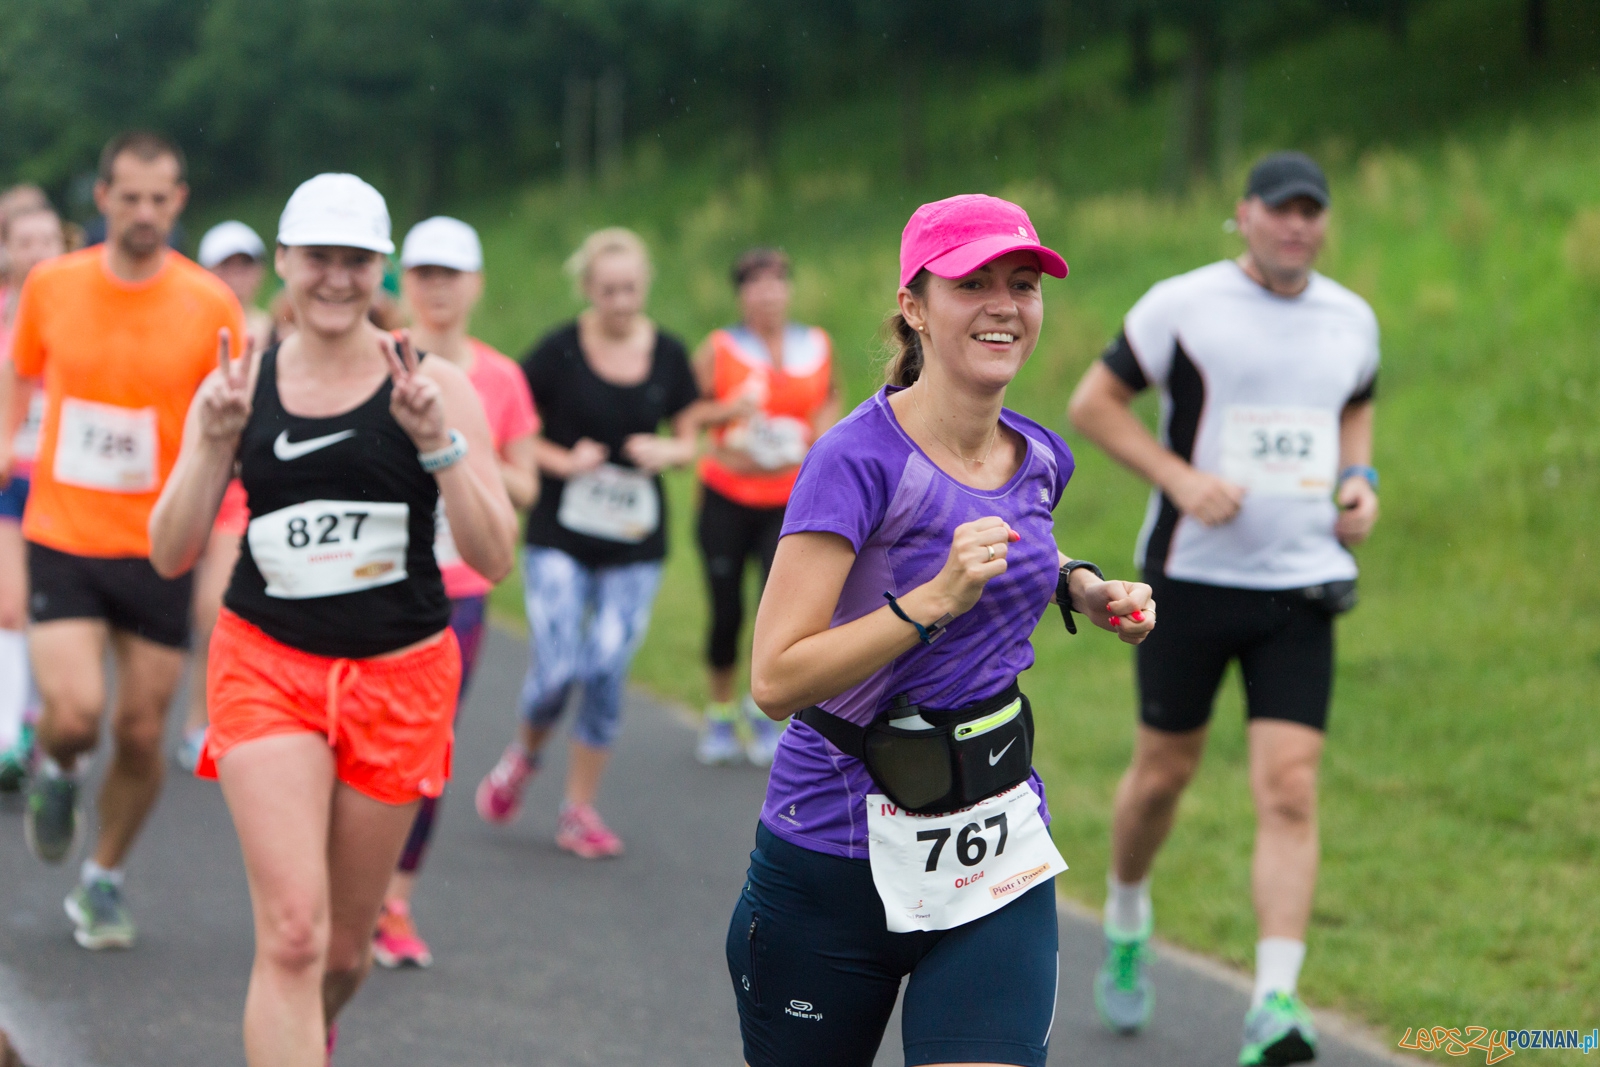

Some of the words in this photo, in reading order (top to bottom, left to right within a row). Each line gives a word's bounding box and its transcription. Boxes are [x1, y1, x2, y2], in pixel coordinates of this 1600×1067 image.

[287, 512, 369, 548] 827
[916, 811, 1008, 873] 767
[954, 870, 985, 889] OLGA
[992, 882, 1016, 896] Piotr
[784, 1007, 823, 1021] Kalenji
